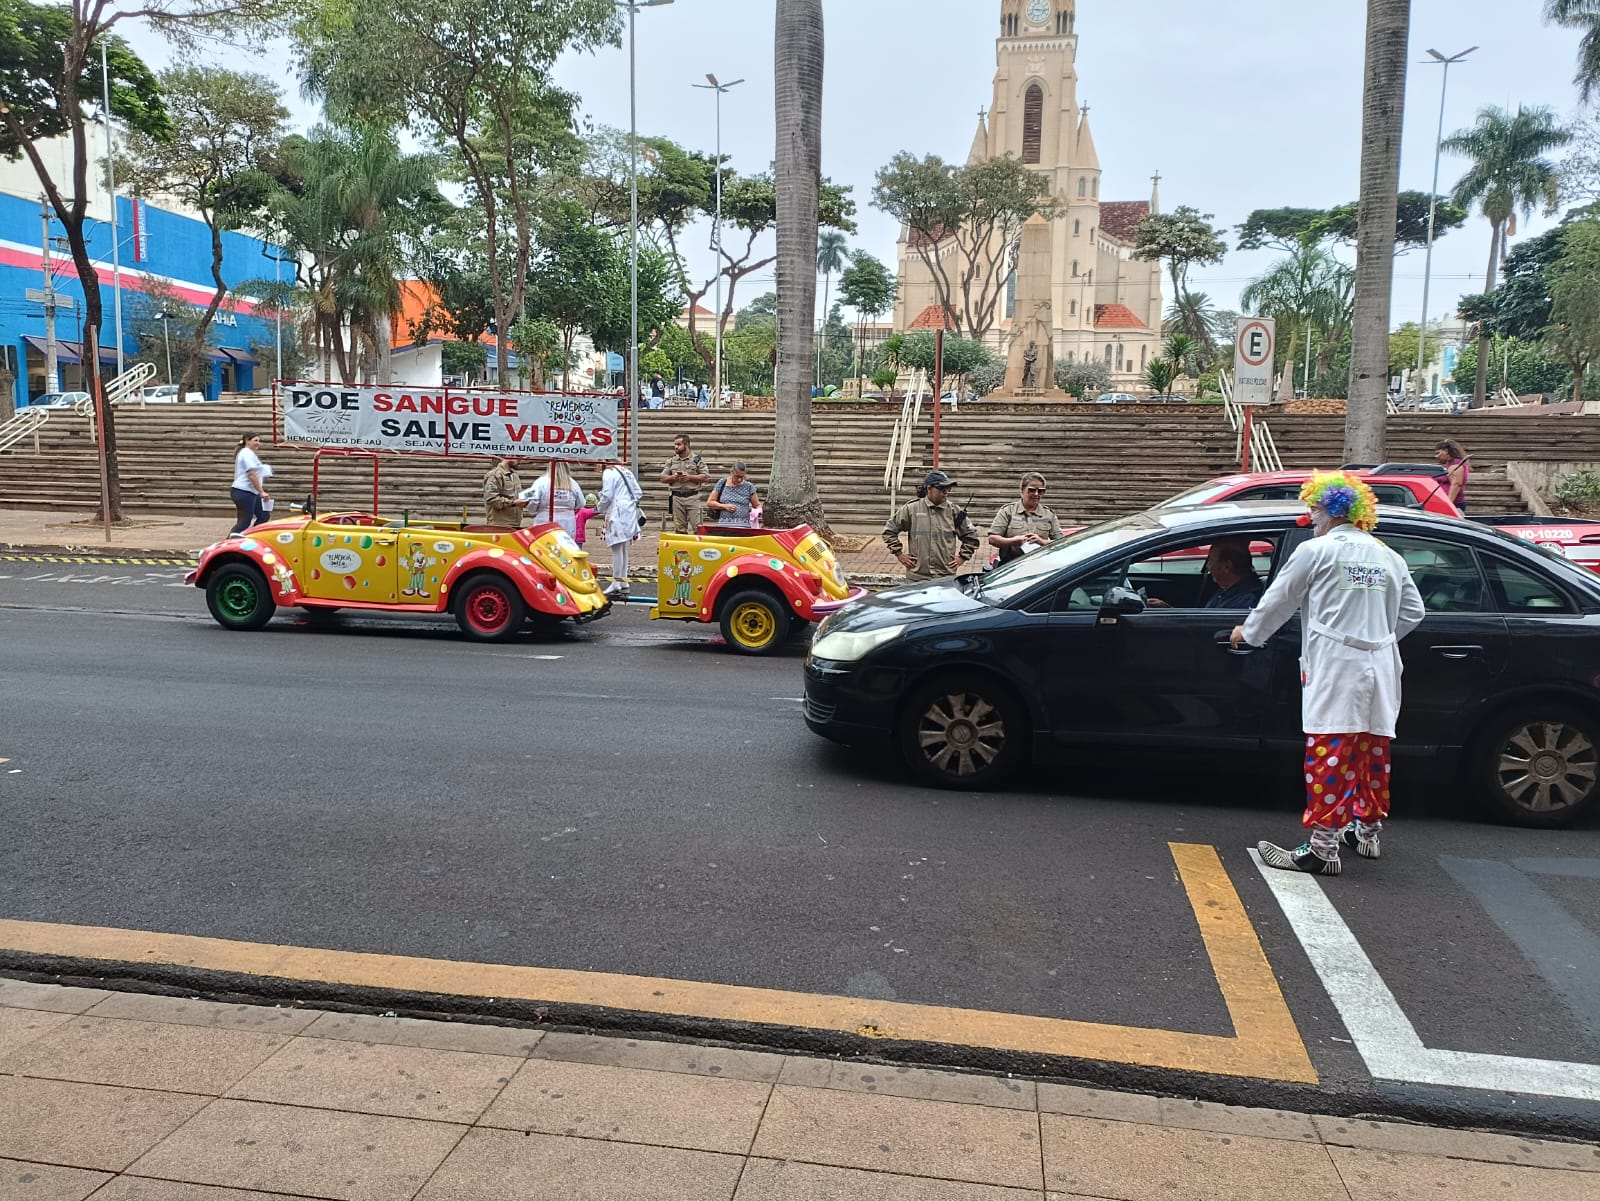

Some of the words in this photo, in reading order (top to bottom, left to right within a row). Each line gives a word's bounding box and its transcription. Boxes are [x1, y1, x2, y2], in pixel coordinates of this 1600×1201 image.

[1250, 332, 1263, 356] E
[292, 391, 360, 411] DOE
[373, 393, 519, 417] SANGUE
[381, 418, 491, 441] SALVE
[505, 423, 613, 446] VIDAS
[405, 440, 433, 448] SEJA
[518, 445, 535, 453] UM
[538, 446, 588, 455] DOADOR
